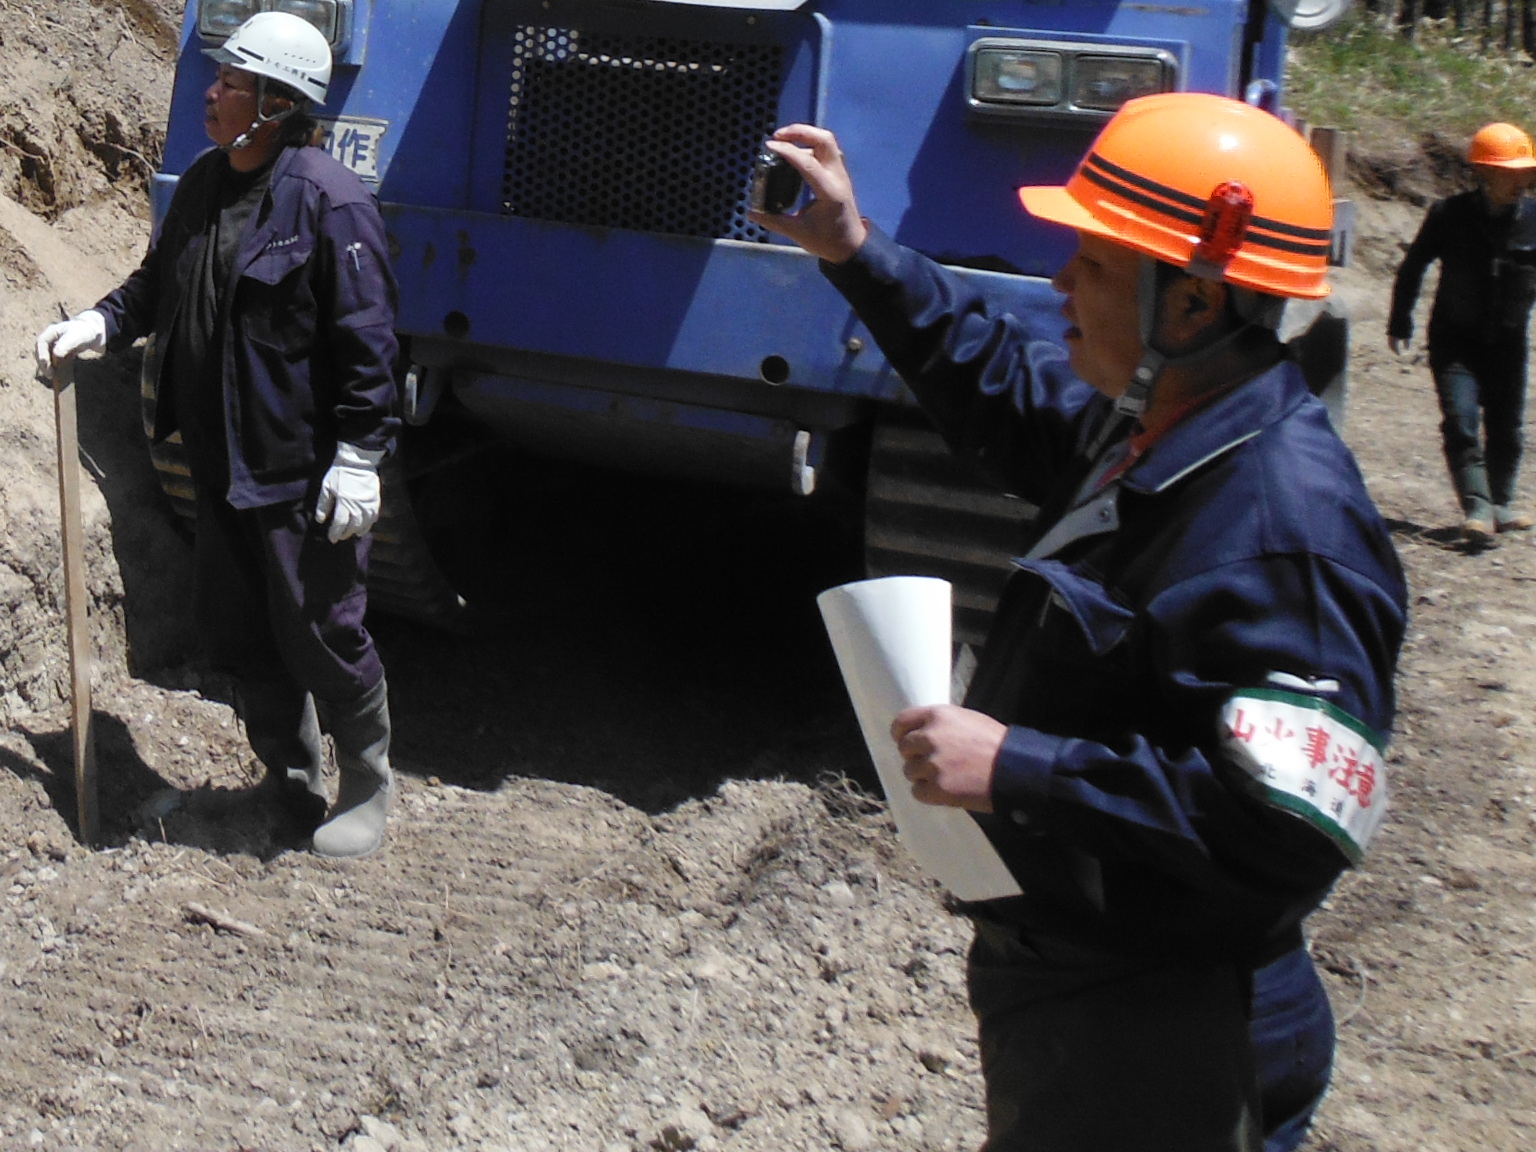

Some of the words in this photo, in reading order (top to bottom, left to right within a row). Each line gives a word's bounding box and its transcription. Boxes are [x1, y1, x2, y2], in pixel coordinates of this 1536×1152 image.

[323, 128, 371, 169] 作
[1232, 708, 1377, 809] 山火事注意
